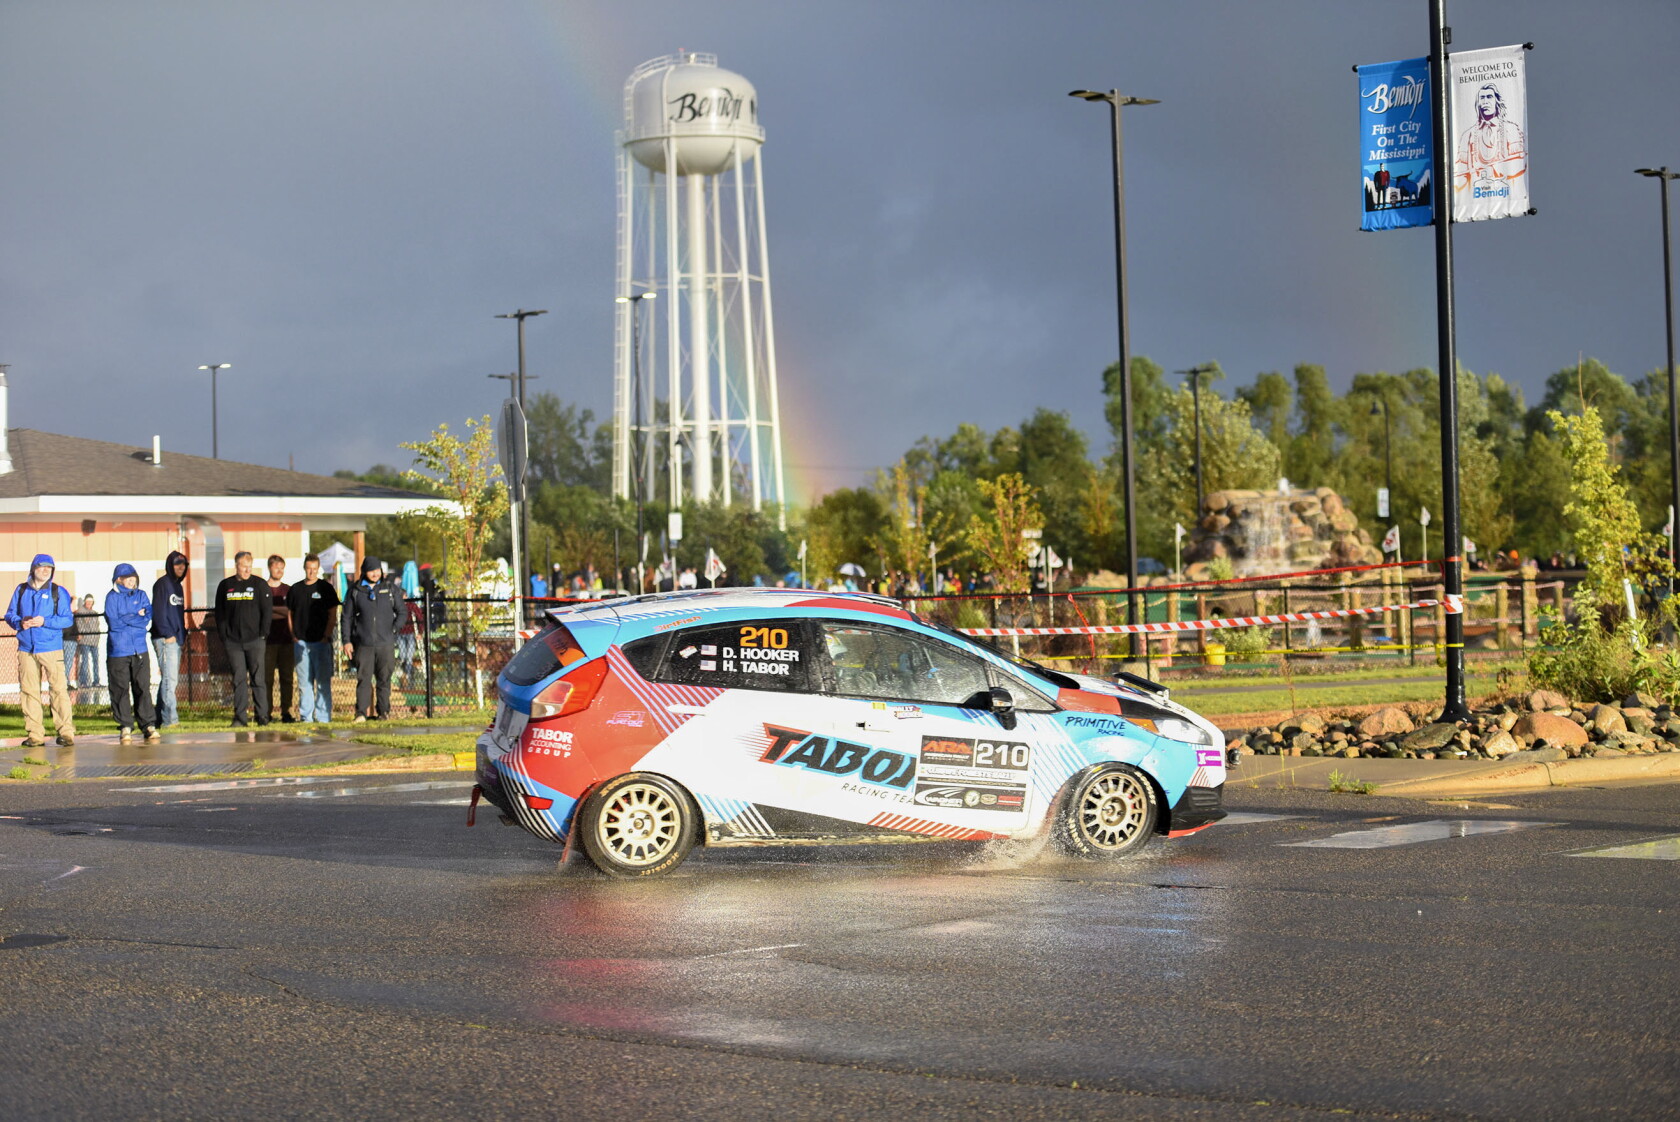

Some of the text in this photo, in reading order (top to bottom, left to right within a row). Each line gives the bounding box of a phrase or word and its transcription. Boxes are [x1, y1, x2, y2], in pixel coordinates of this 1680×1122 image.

[1461, 62, 1514, 75] WELCOME TO
[1459, 70, 1517, 84] BEMIJIGAMAAG
[1361, 75, 1426, 120] Bemidji
[1371, 121, 1422, 136] First City
[1377, 133, 1418, 148] On The
[1368, 144, 1426, 161] Mississippi
[1473, 186, 1510, 199] Bemidji
[739, 626, 789, 650] 210
[722, 646, 800, 662] D. HOOKER
[722, 659, 790, 676] H. TABOR
[1065, 716, 1127, 731] PRIMITIVE
[532, 727, 574, 744] TABOR
[1097, 728, 1126, 737] RACING
[527, 747, 572, 758] GROUP
[529, 739, 572, 751] ACCOUNTING
[921, 739, 973, 755] ARA
[976, 742, 1030, 768] 210
[841, 782, 889, 800] RACING
